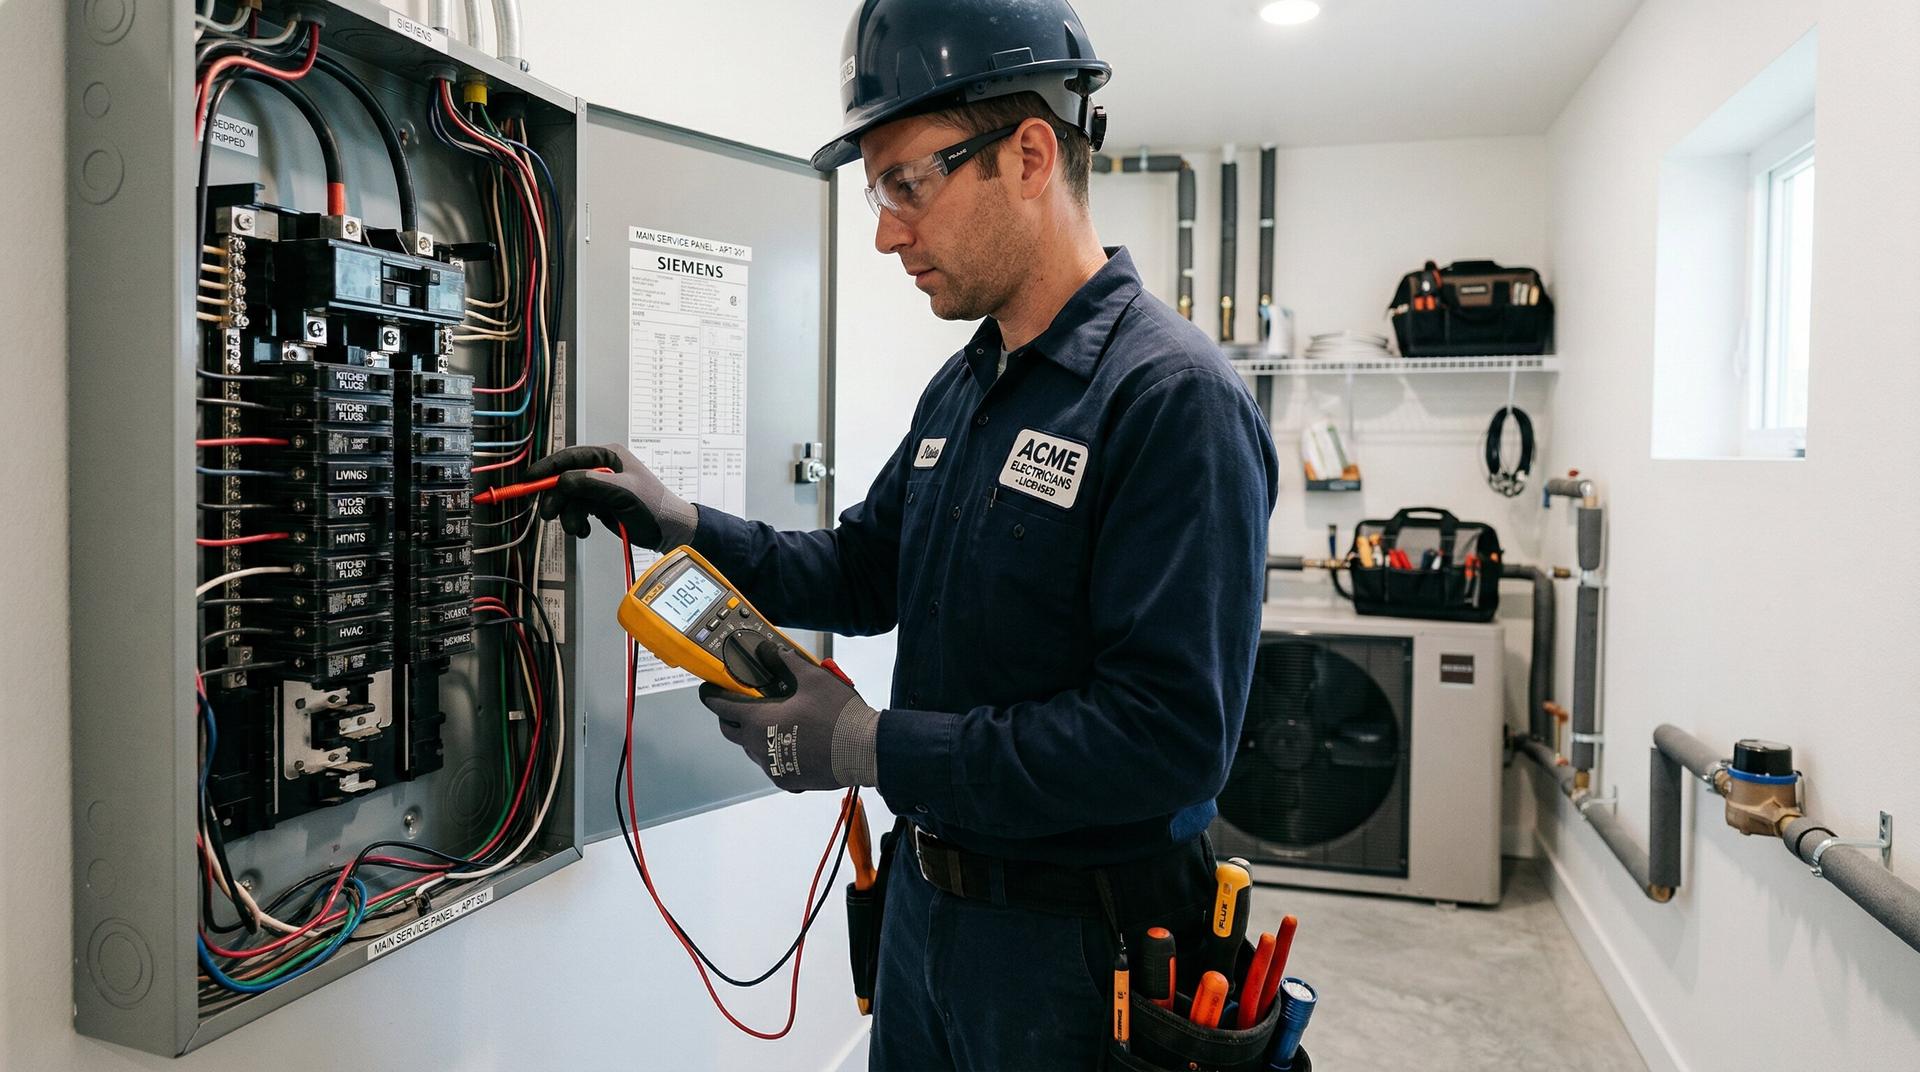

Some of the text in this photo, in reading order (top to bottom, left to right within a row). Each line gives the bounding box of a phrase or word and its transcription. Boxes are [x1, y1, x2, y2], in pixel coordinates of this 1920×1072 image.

[397, 17, 432, 43] SIEMENS
[211, 131, 246, 148] TRIPPED
[635, 230, 655, 242] MAIN
[657, 233, 689, 248] SERVICE
[690, 239, 713, 252] PANEL
[657, 256, 723, 279] SIEMENS
[1016, 438, 1081, 476] ACME
[335, 470, 368, 480] LIVINGS
[1009, 460, 1072, 490] ELECTRICIANS
[339, 625, 364, 638] HVAC
[374, 936, 395, 955] MAIN
[396, 920, 430, 944] SERVICE
[430, 908, 455, 928] PANEL
[461, 896, 476, 913] APT
